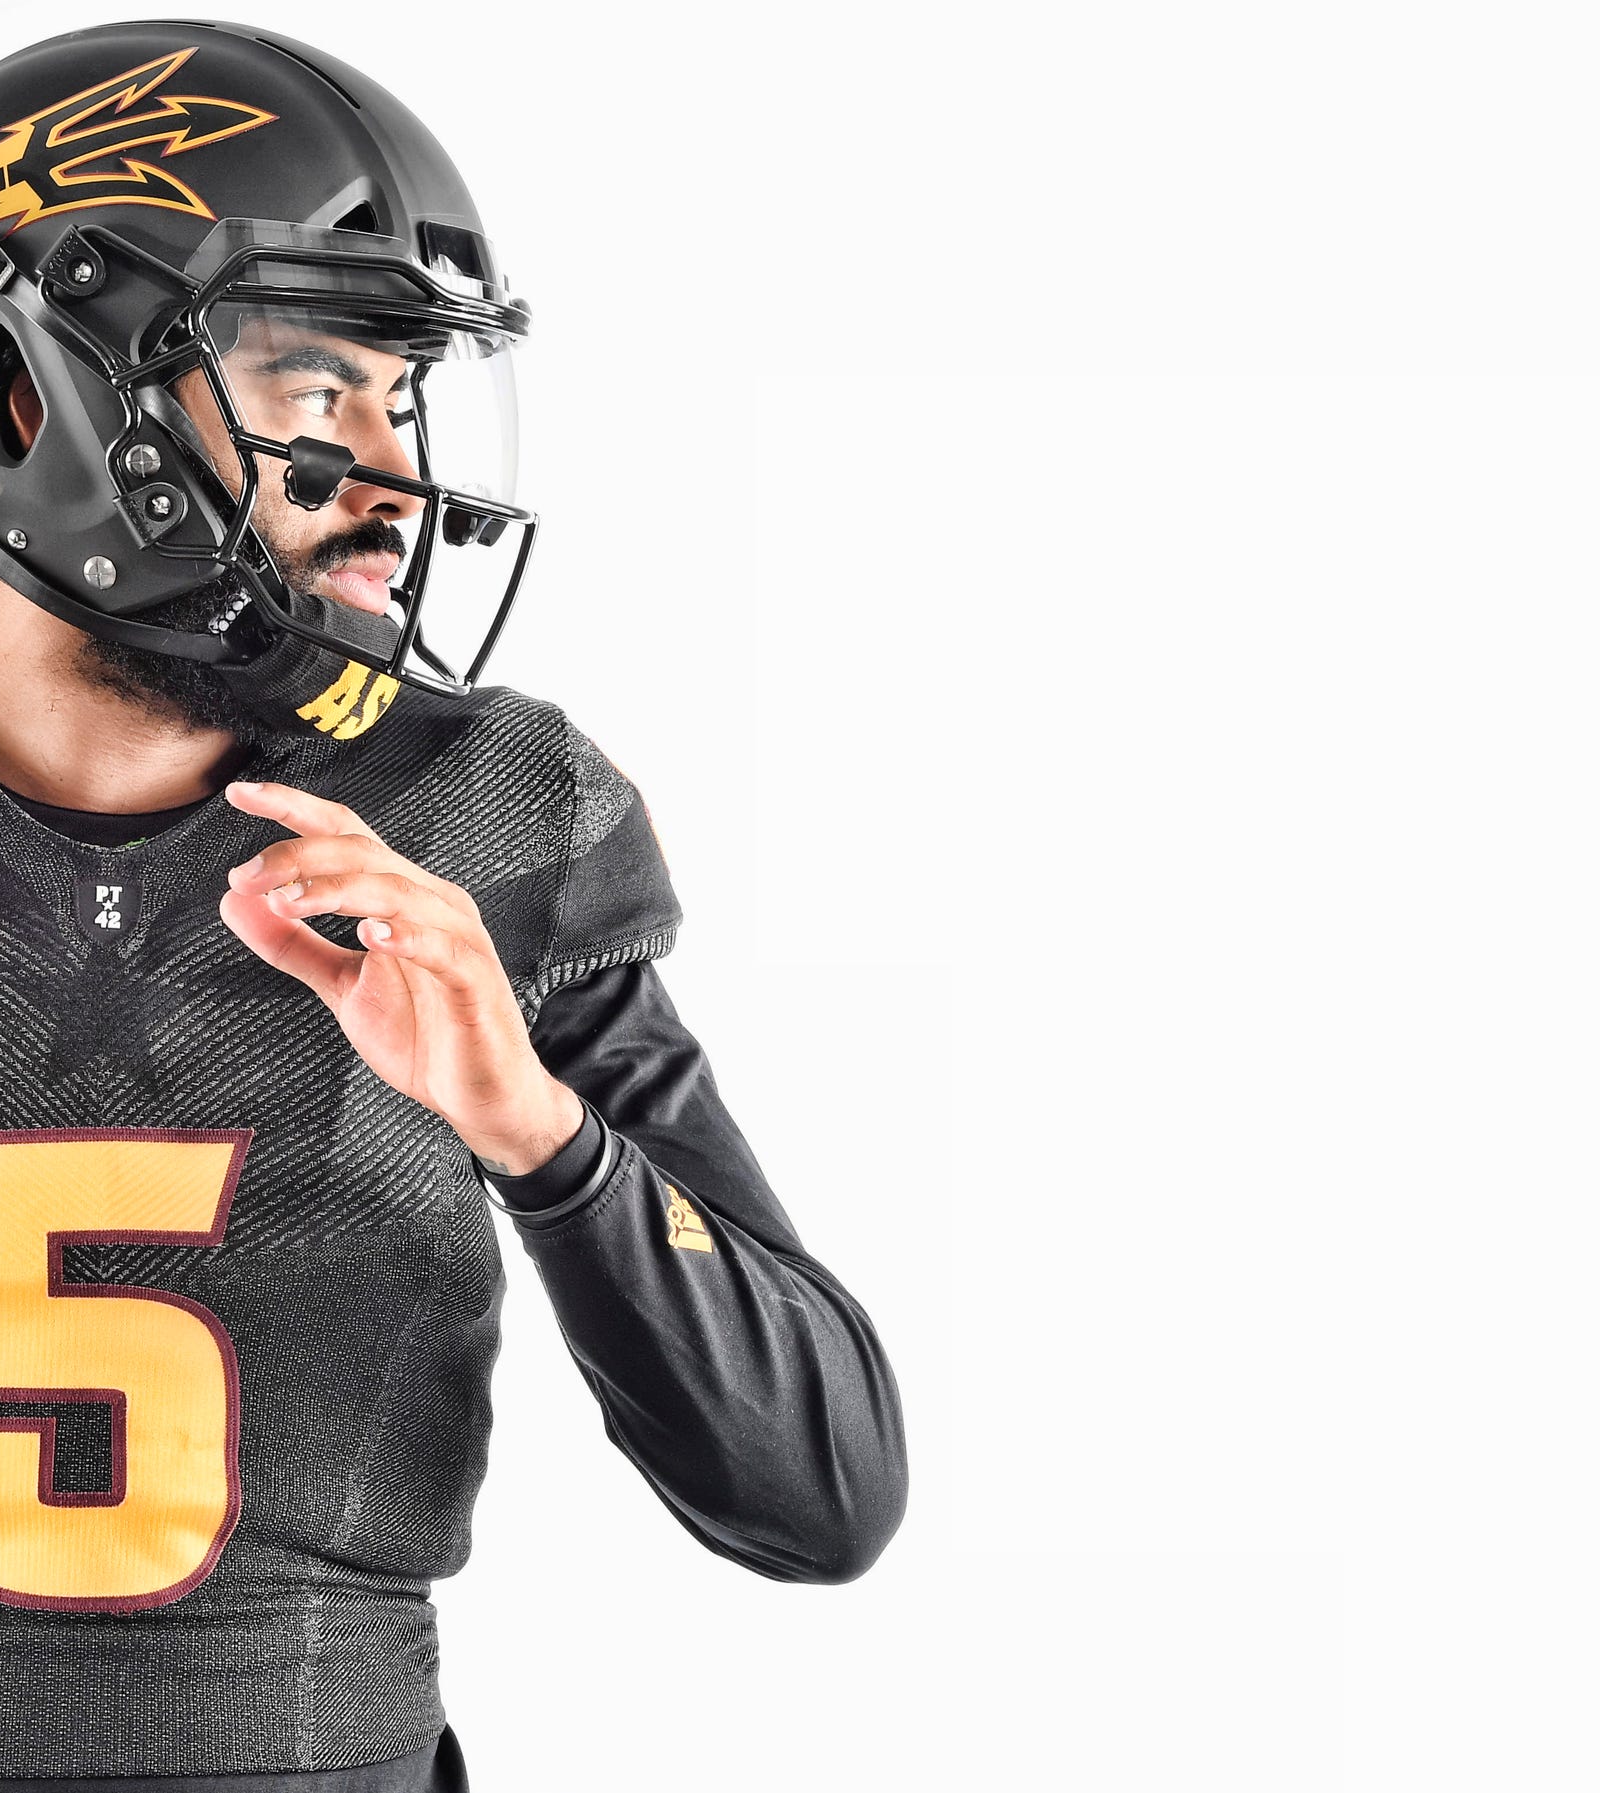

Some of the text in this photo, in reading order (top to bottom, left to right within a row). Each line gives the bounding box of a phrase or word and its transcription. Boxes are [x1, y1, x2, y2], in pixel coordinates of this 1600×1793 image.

[294, 658, 402, 741] AS
[95, 885, 123, 904] PT
[94, 910, 121, 929] 42
